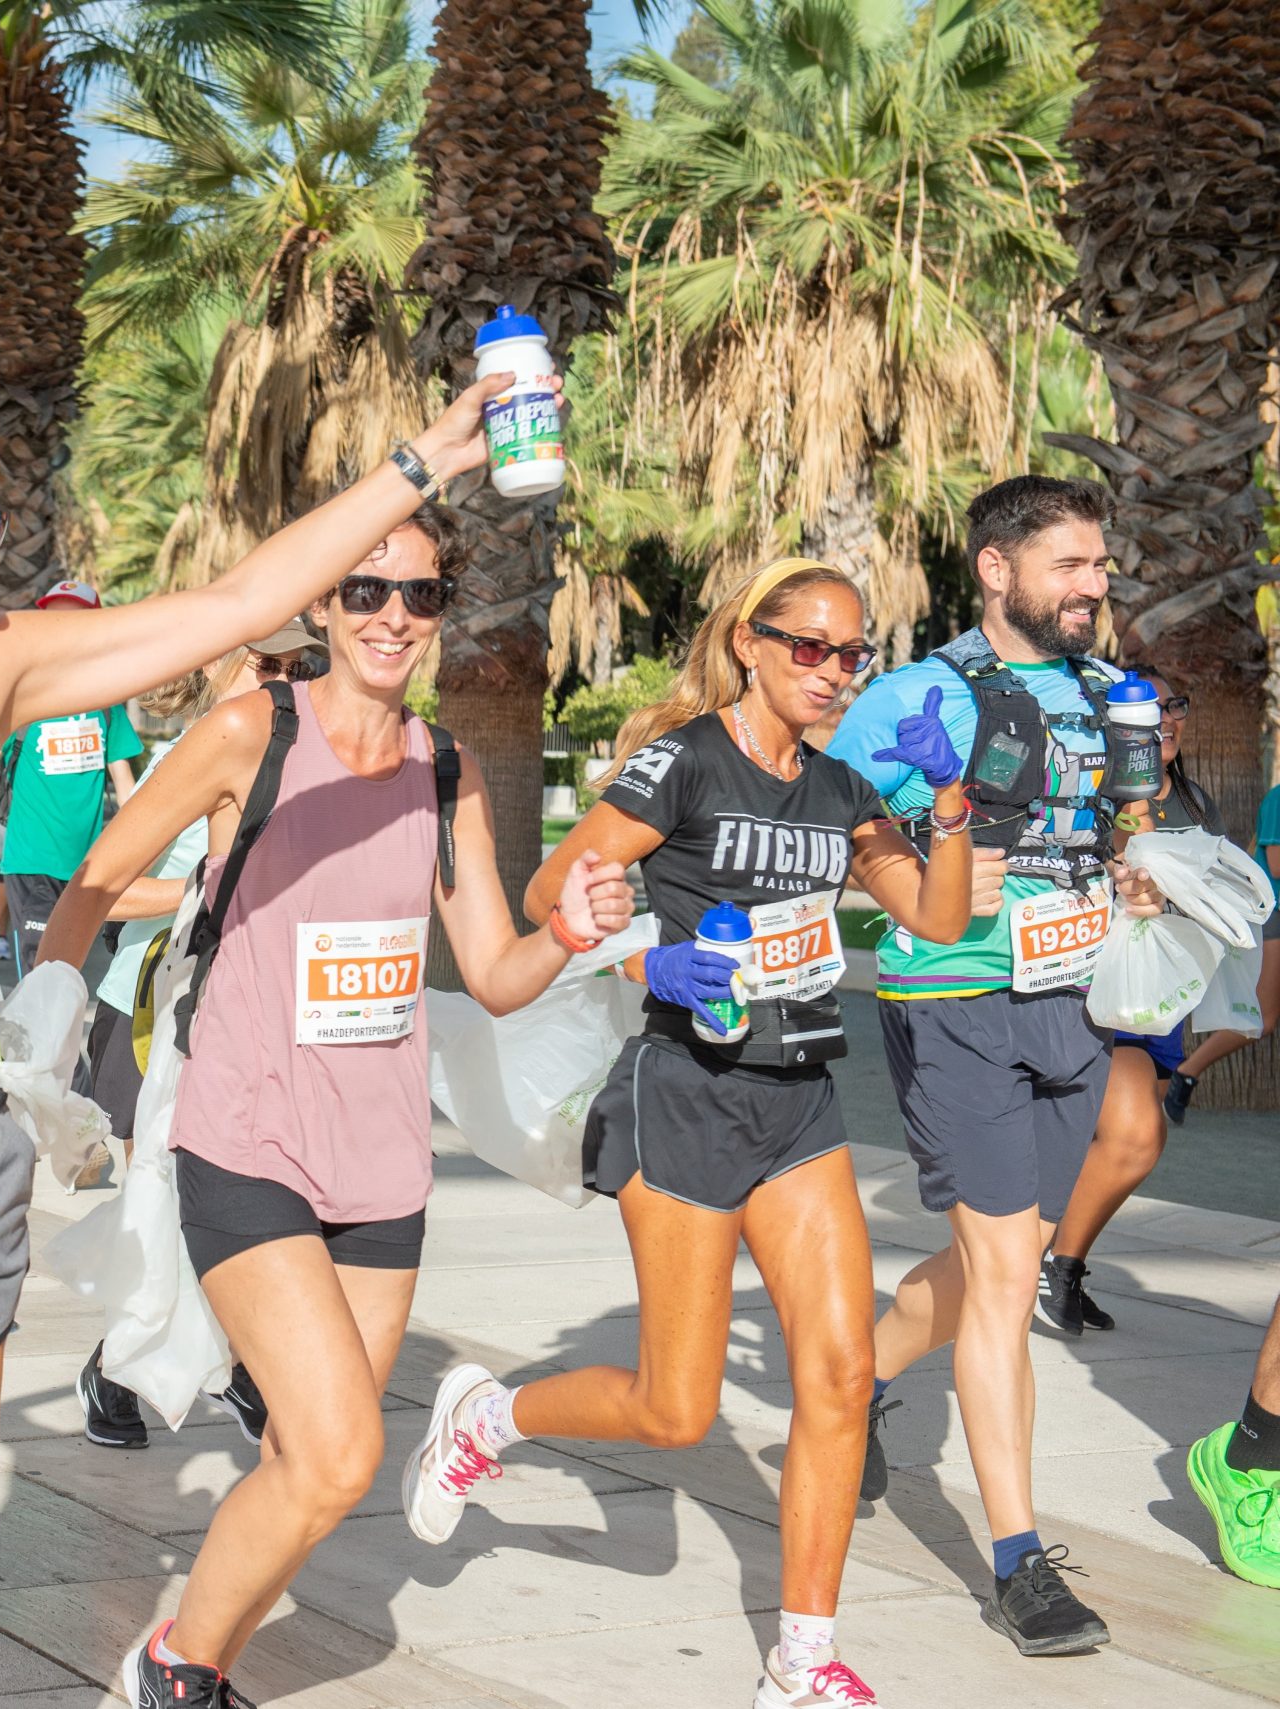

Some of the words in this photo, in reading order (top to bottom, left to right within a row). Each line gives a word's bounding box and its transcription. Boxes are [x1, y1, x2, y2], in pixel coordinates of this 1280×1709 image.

[517, 420, 536, 440] EL
[651, 739, 684, 755] ALIFE
[1129, 747, 1149, 762] HAZ
[1127, 759, 1149, 773] POR
[712, 821, 847, 884] FITCLUB
[753, 876, 811, 892] MALAGA
[24, 920, 47, 931] JOM
[1028, 914, 1103, 955] 19262
[753, 925, 822, 970] 18877
[322, 960, 412, 996] 18107
